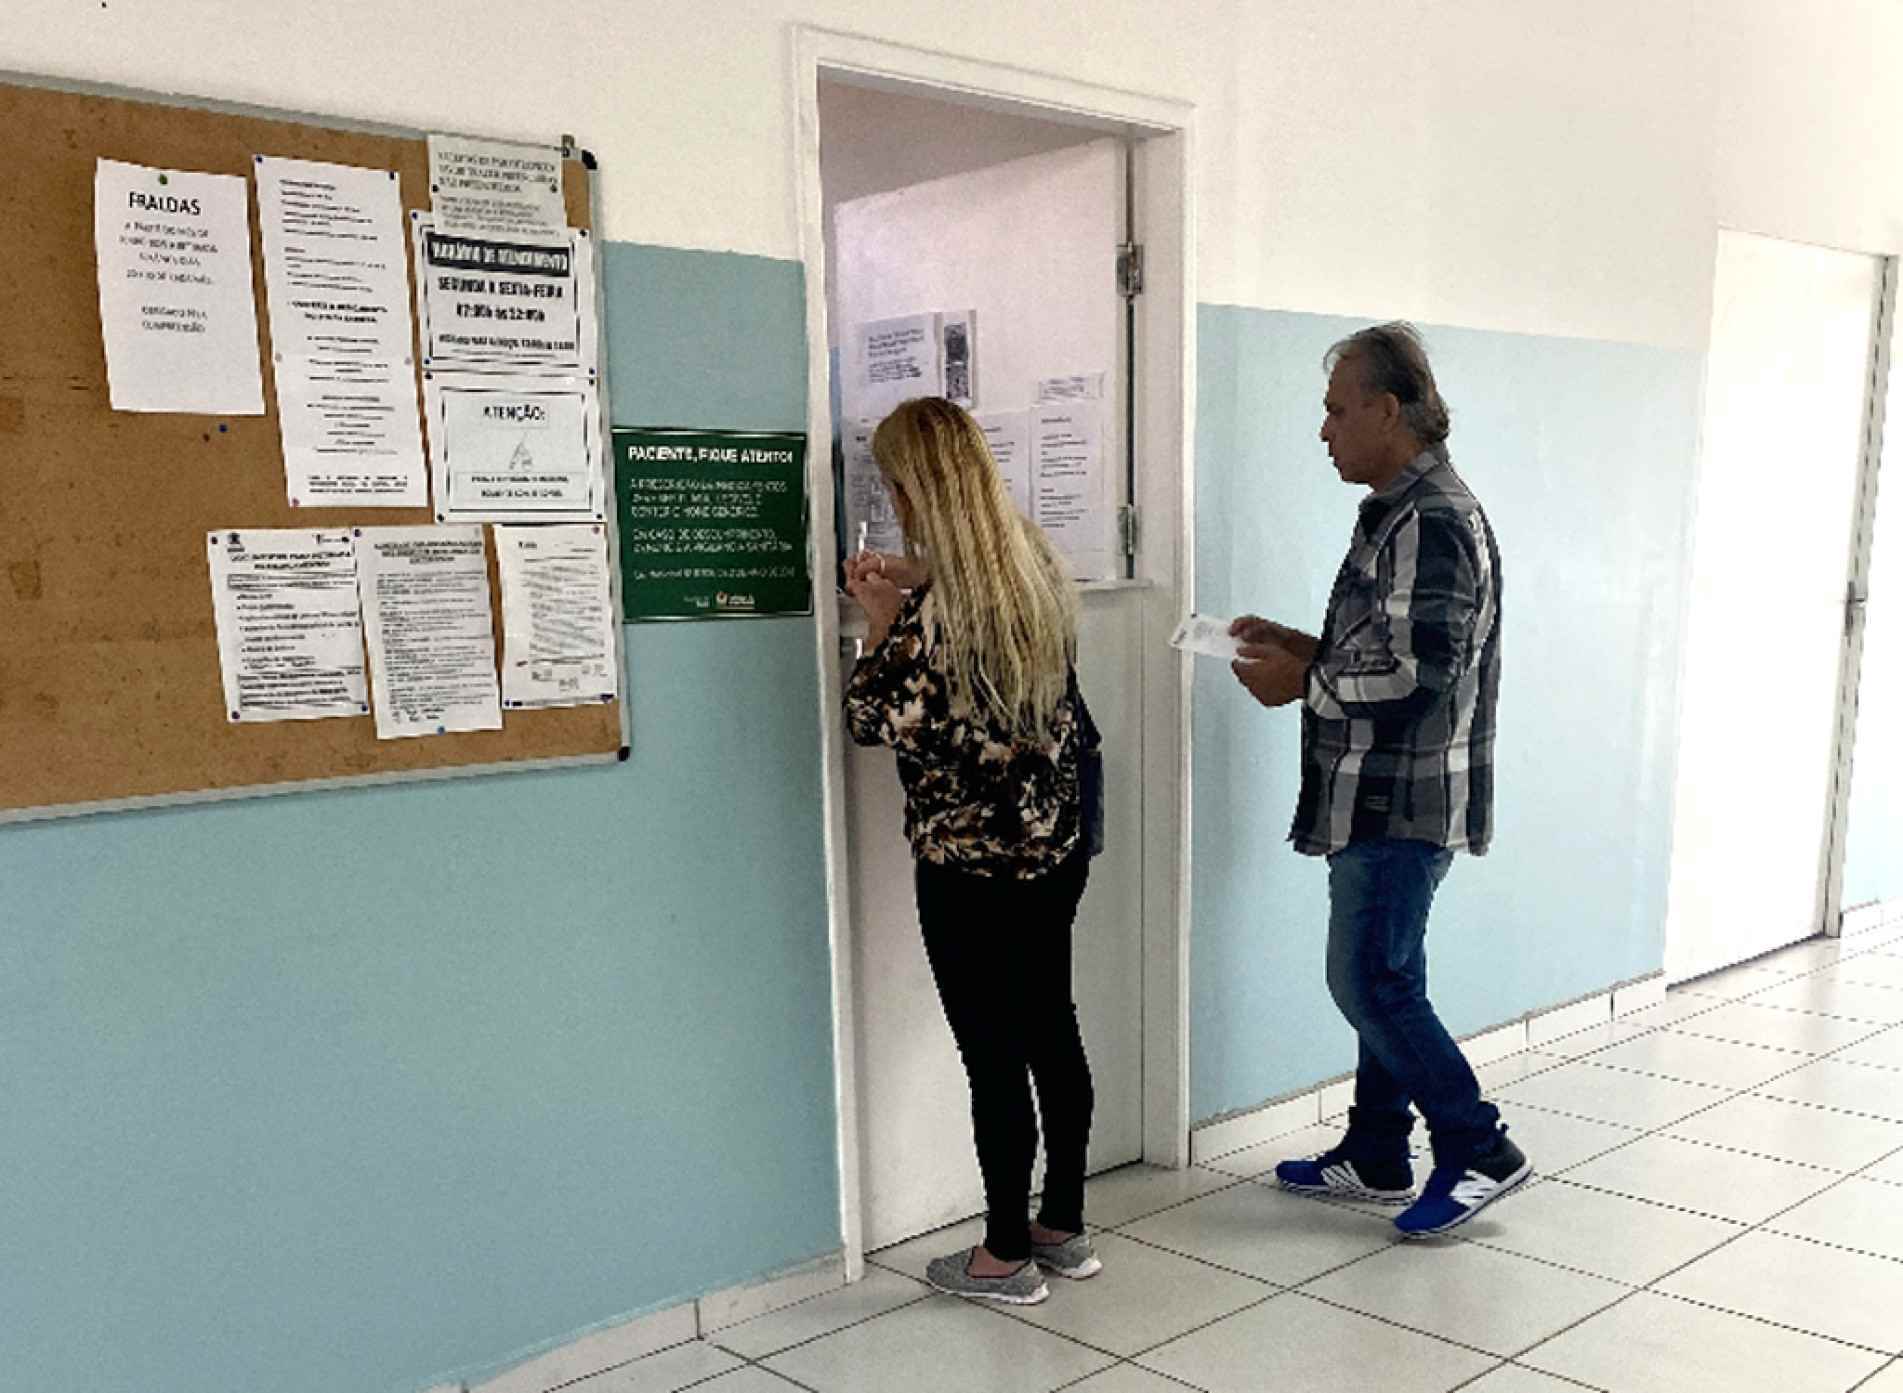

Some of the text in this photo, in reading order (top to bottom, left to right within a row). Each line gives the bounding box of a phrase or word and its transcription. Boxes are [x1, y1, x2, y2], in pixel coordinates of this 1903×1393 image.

[129, 191, 201, 216] FRALDAS
[438, 276, 486, 293] SEGUNDA
[499, 281, 563, 298] SEXTA-FEIRA
[484, 404, 545, 421] ATENÇÃO:
[628, 446, 697, 463] PACIENTE,
[700, 448, 737, 463] FIQUE
